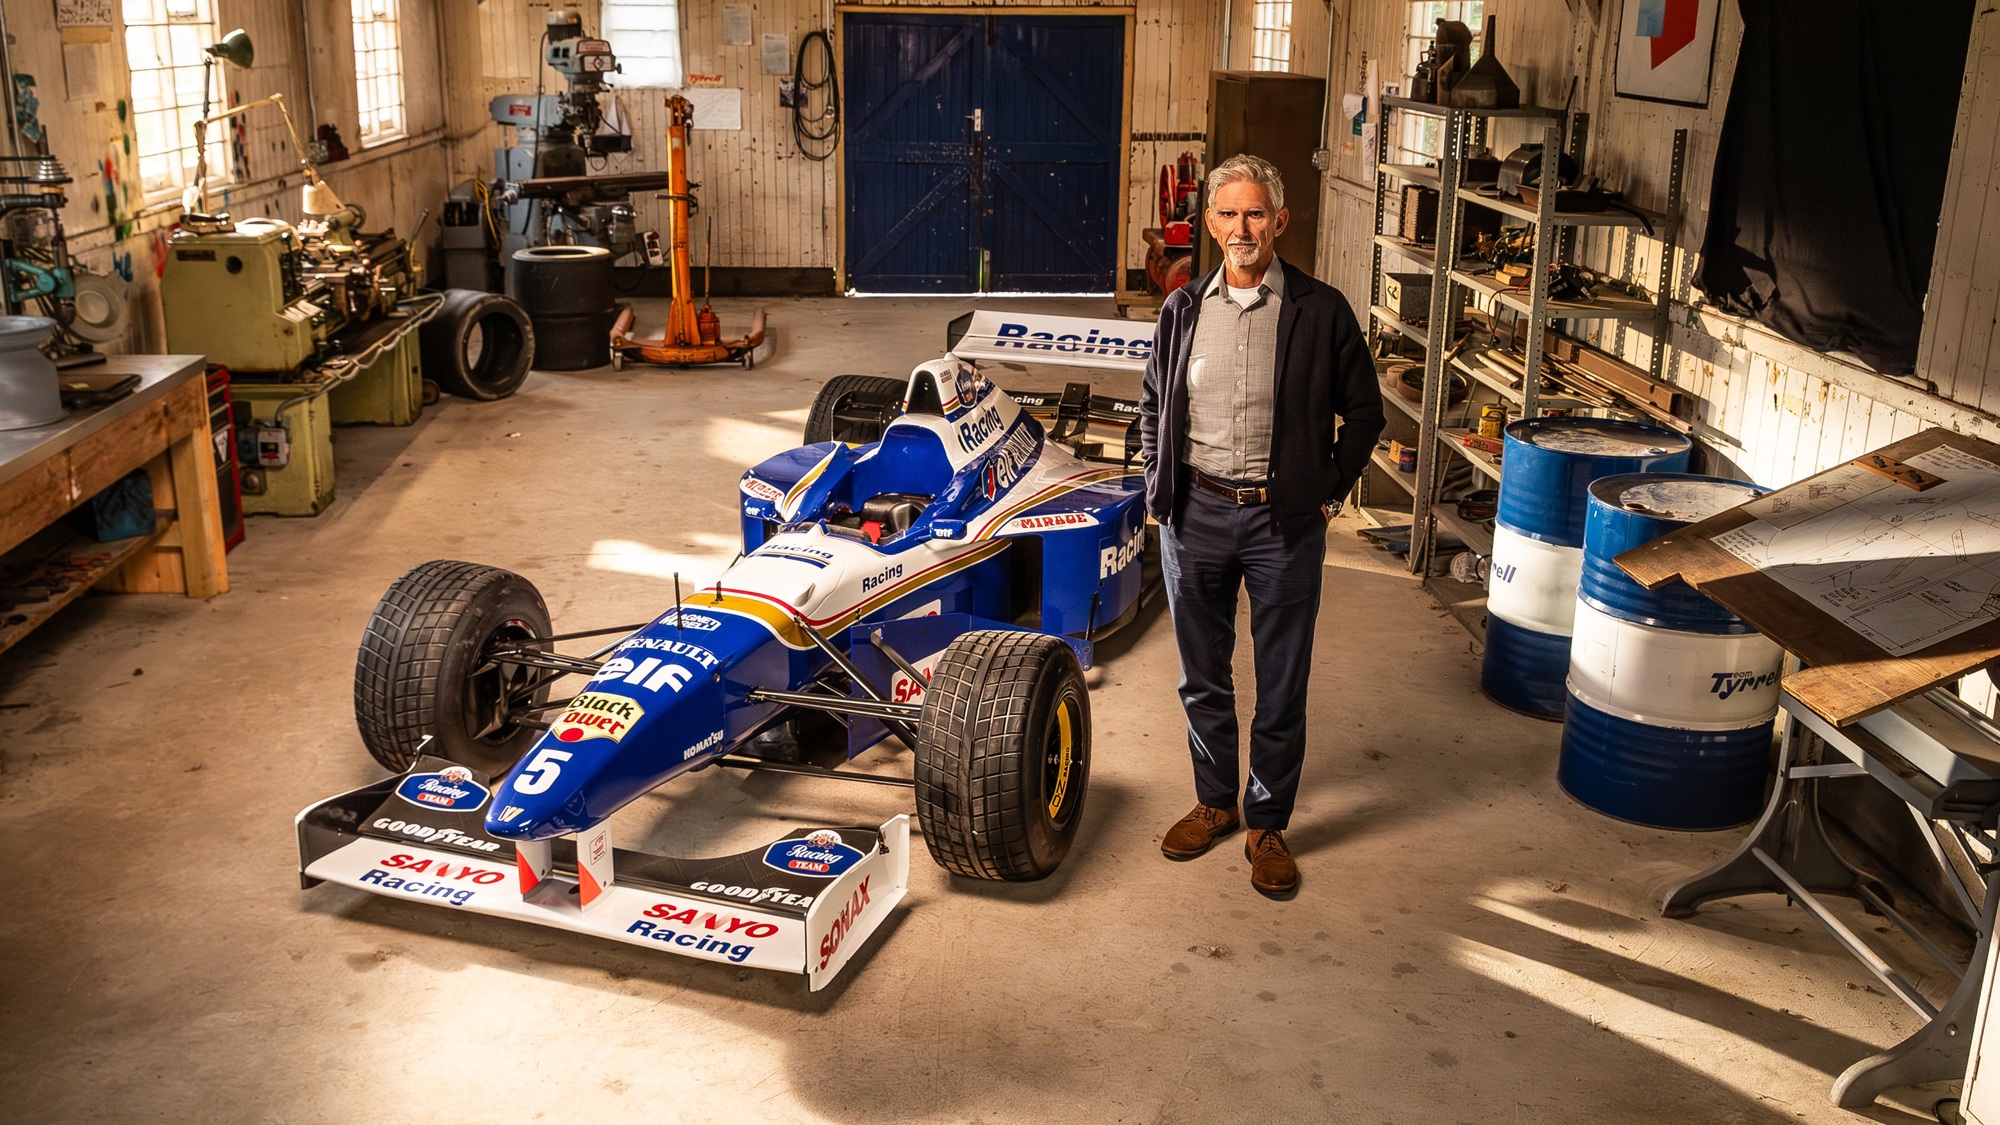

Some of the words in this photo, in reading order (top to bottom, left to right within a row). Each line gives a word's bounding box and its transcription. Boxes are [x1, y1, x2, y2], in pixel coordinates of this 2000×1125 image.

[994, 323, 1153, 360] Racing
[1113, 402, 1140, 413] Rac
[960, 404, 1005, 452] Racing
[862, 563, 903, 593] Racing
[590, 656, 693, 693] elf
[570, 695, 634, 720] Black
[684, 729, 724, 760] KOMATSU
[513, 749, 573, 795] 5
[418, 779, 470, 800] Racing
[424, 794, 450, 806] TEAM
[373, 818, 500, 852] GOODYEAR
[381, 854, 506, 885] SANYO
[786, 844, 844, 864] Racing
[795, 860, 823, 872] TEAM
[359, 869, 476, 906] Racing
[690, 881, 815, 908] GOODYEA
[643, 903, 779, 939] SANYO
[819, 874, 872, 971] SONAX
[626, 919, 756, 963] Racing
